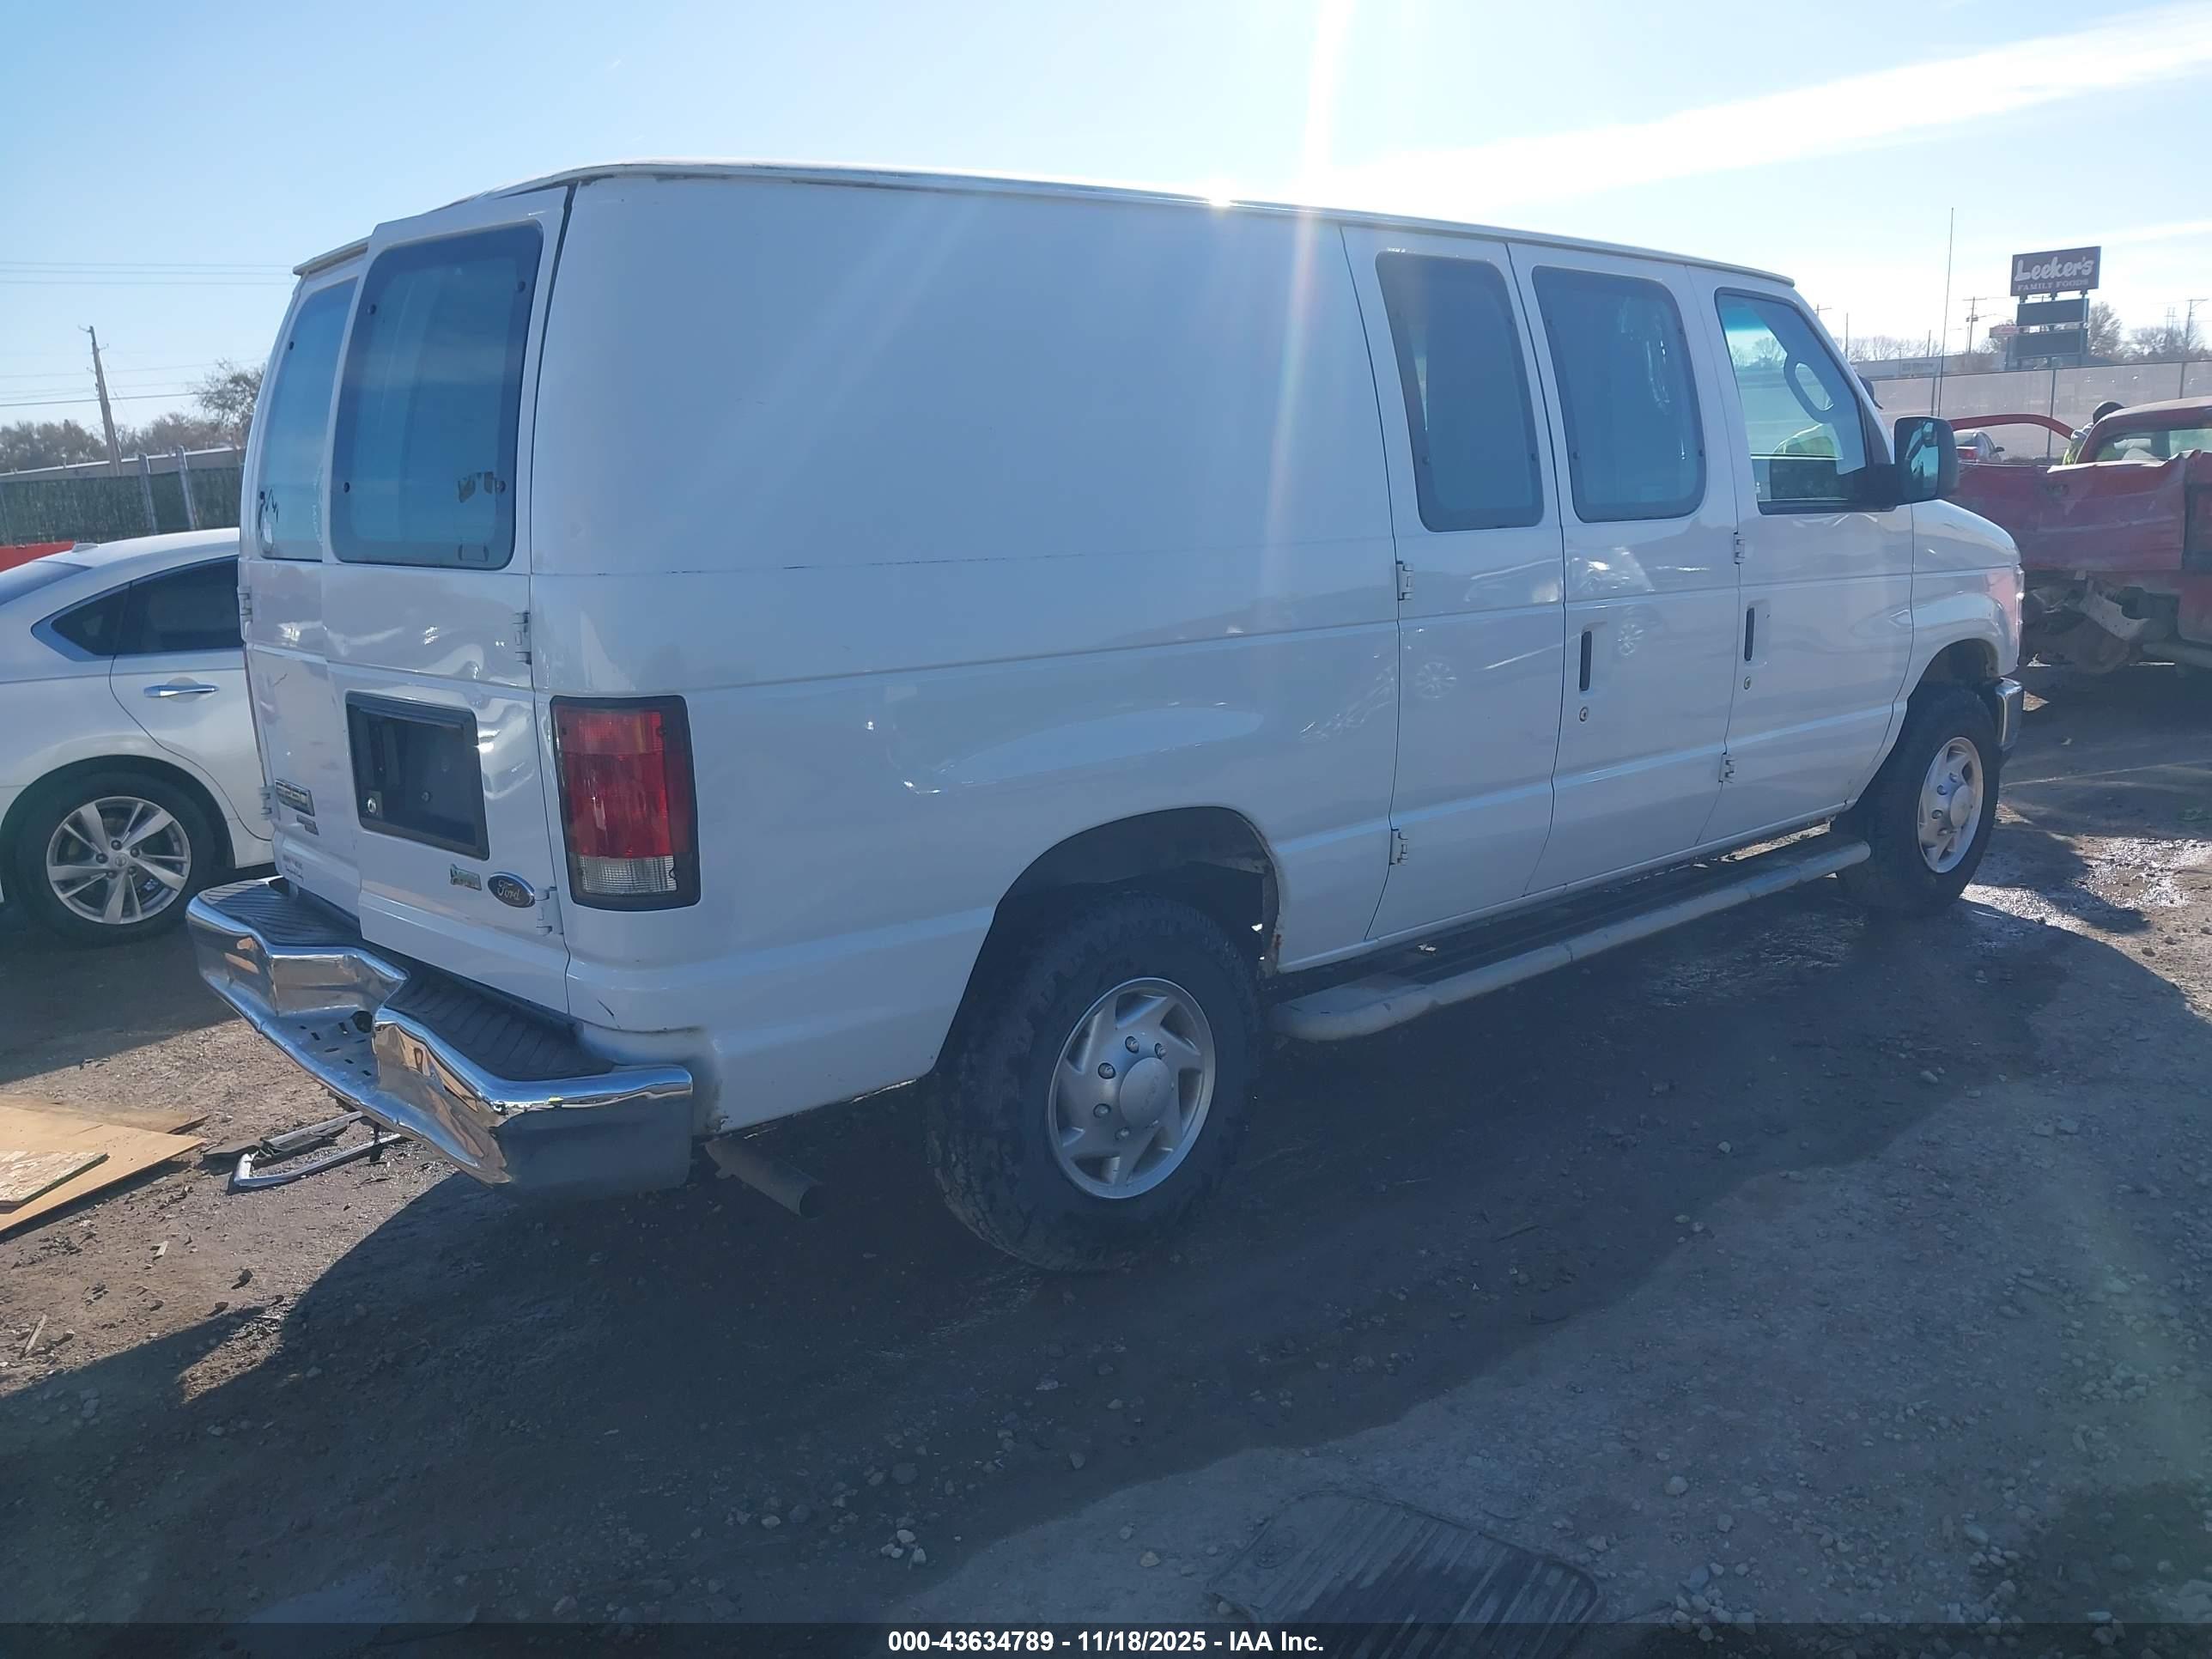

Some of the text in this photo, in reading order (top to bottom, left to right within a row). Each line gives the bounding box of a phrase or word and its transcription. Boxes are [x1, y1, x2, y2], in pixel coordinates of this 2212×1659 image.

[2014, 256, 2094, 282] Leeker's
[2017, 278, 2089, 291] FAMILY FOODS
[497, 879, 522, 901] Ford
